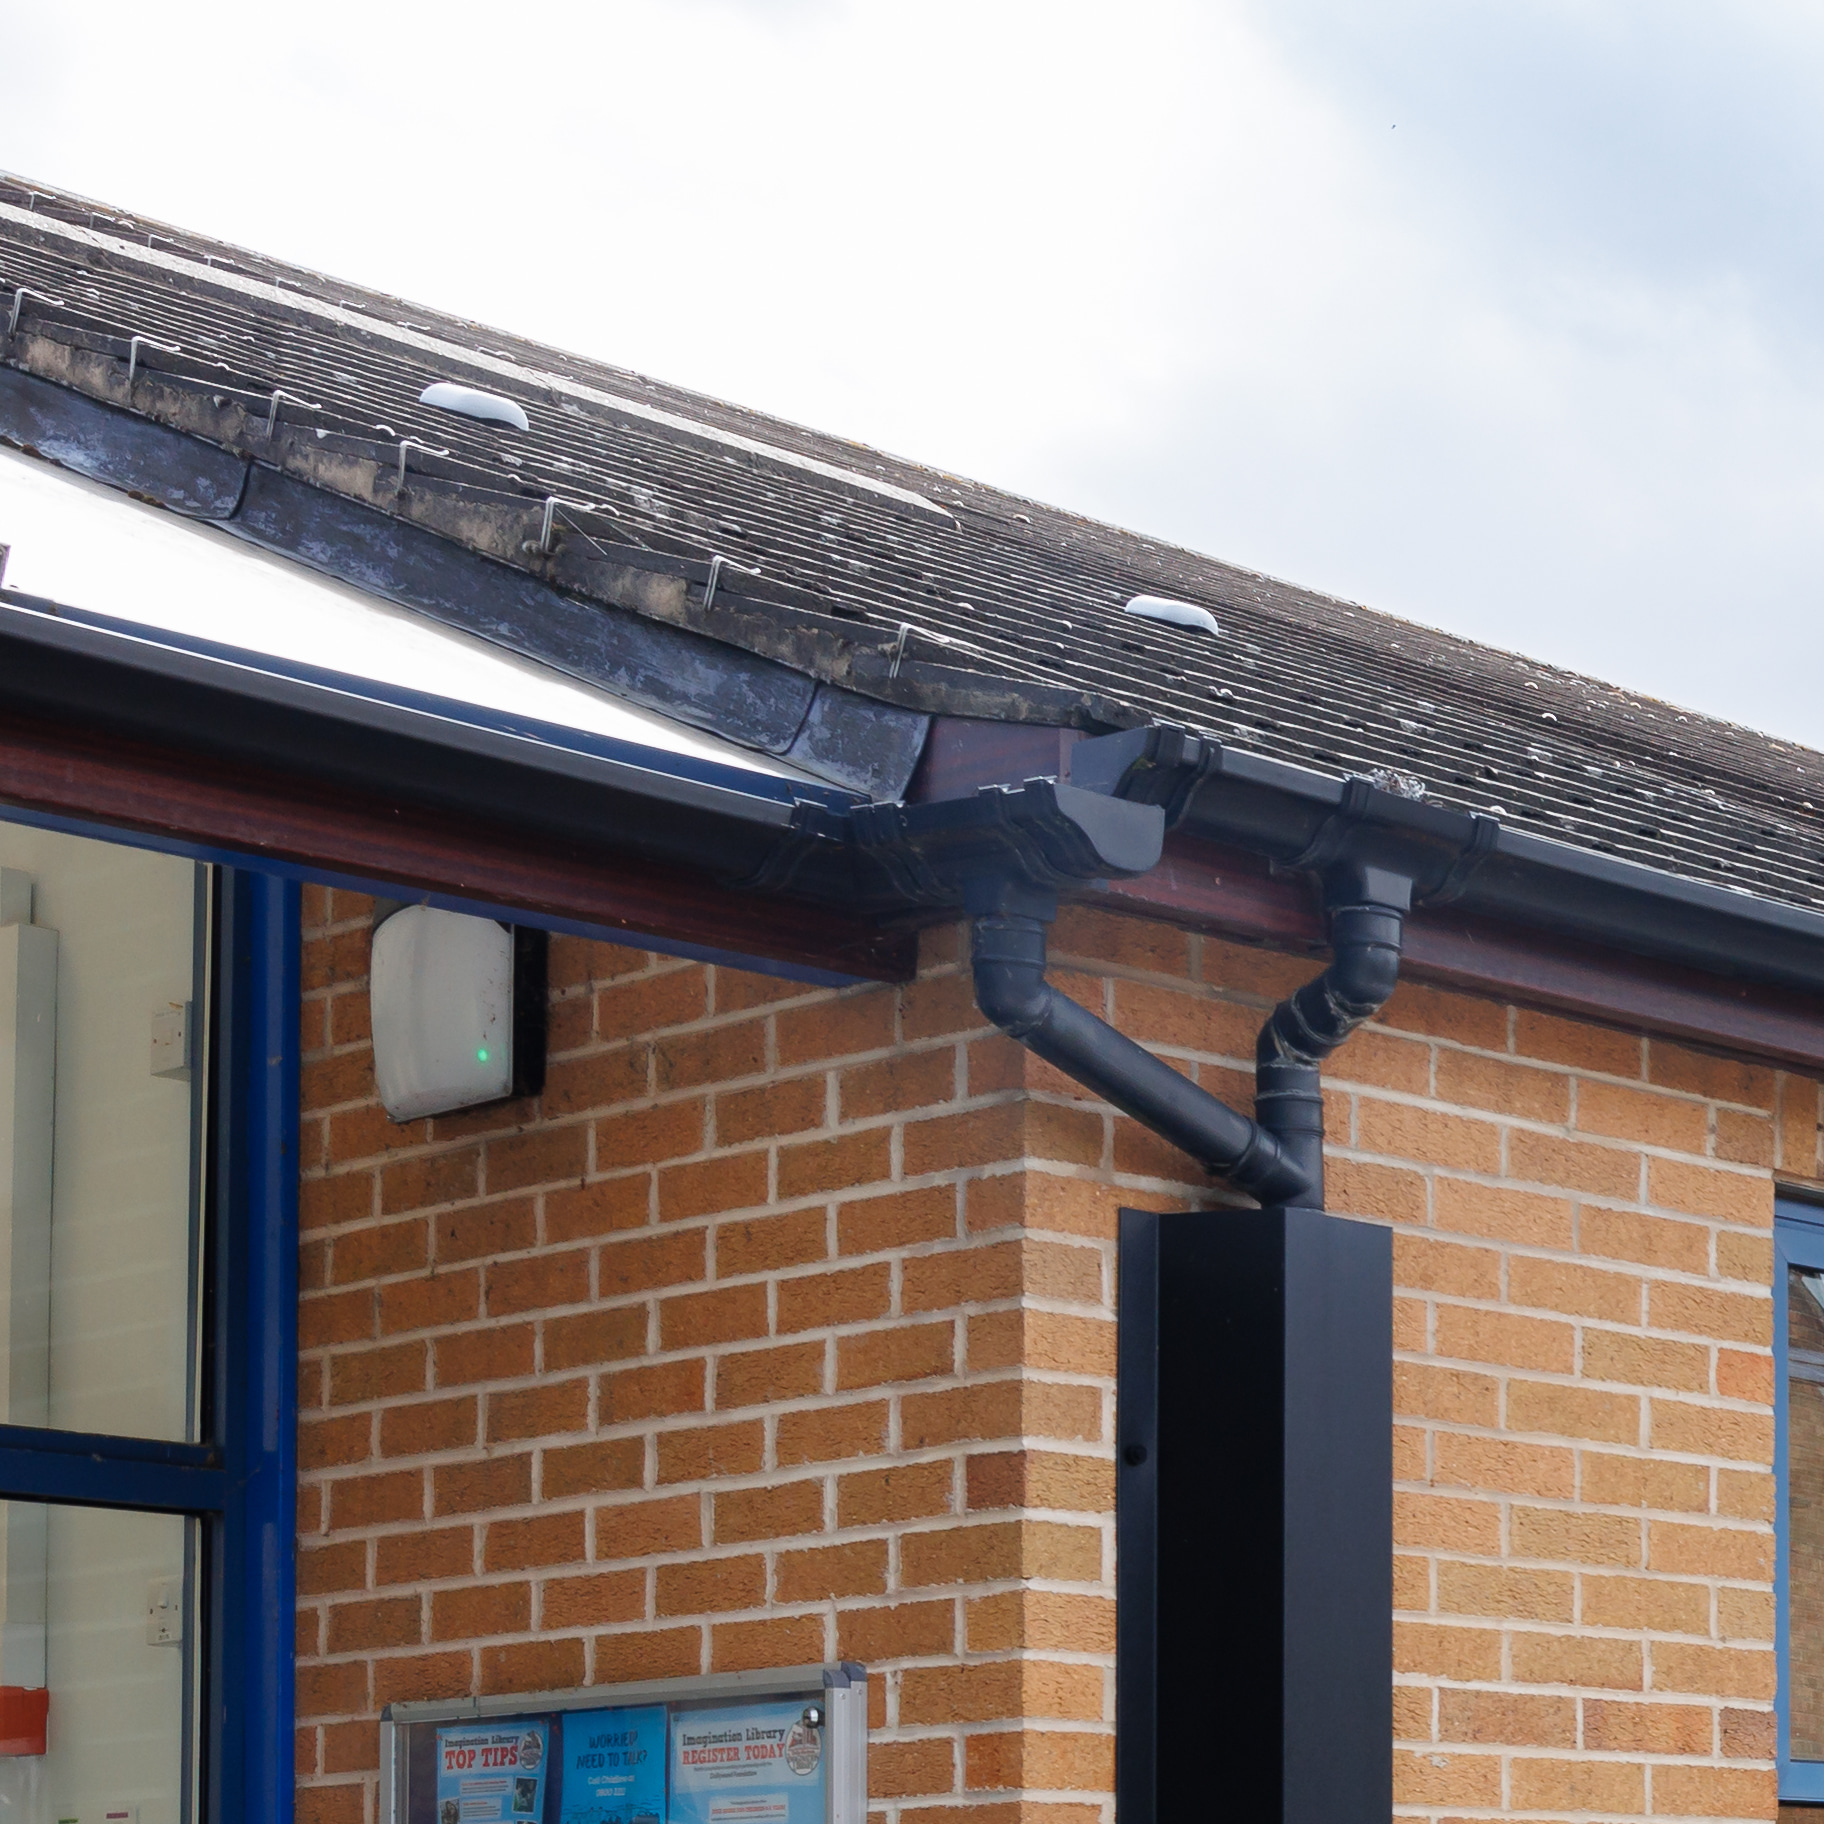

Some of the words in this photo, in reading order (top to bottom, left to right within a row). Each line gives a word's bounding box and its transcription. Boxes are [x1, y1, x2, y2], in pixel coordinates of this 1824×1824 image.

[445, 1737, 488, 1749] Imagination
[491, 1735, 519, 1747] Library
[682, 1730, 742, 1747] Imagination
[746, 1728, 785, 1741] Library
[445, 1749, 476, 1770] TOP
[481, 1745, 518, 1767] TIPS
[576, 1753, 604, 1770] NEED
[608, 1752, 620, 1767] TO
[682, 1747, 740, 1765] REGISTER
[745, 1743, 785, 1760] TODAY
